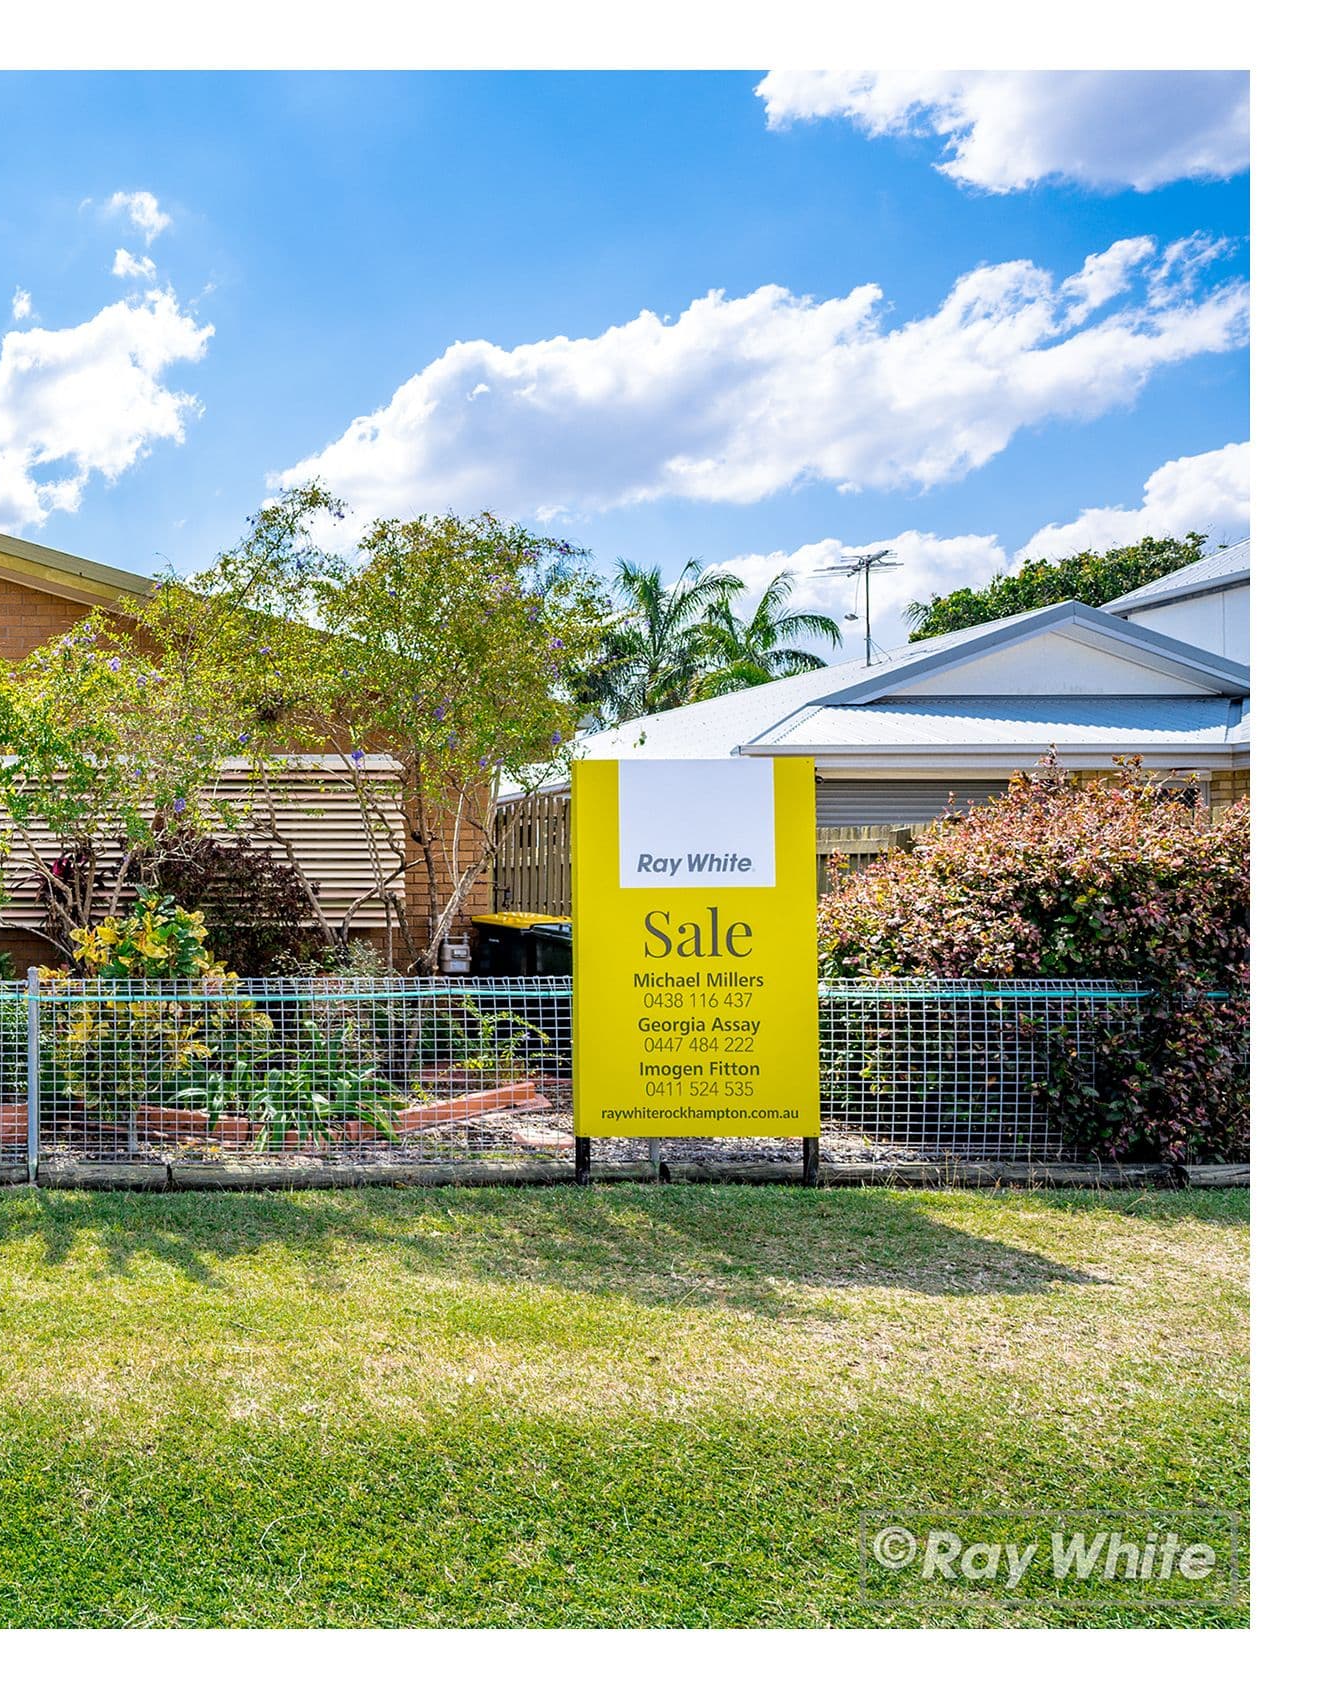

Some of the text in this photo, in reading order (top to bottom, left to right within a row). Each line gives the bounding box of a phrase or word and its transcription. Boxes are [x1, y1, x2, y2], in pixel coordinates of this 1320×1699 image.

[637, 853, 753, 876] Ray White
[644, 907, 753, 959] Sale
[633, 972, 764, 988] Michael Millers
[643, 992, 753, 1009] 0438 116 437
[638, 1017, 761, 1035] Georgia Assay
[644, 1037, 754, 1053] 0447 484 222
[639, 1061, 760, 1079] Imogen Fitton
[645, 1081, 754, 1097] 0411 524 535
[601, 1107, 799, 1121] raywhiterockhampton.com.au
